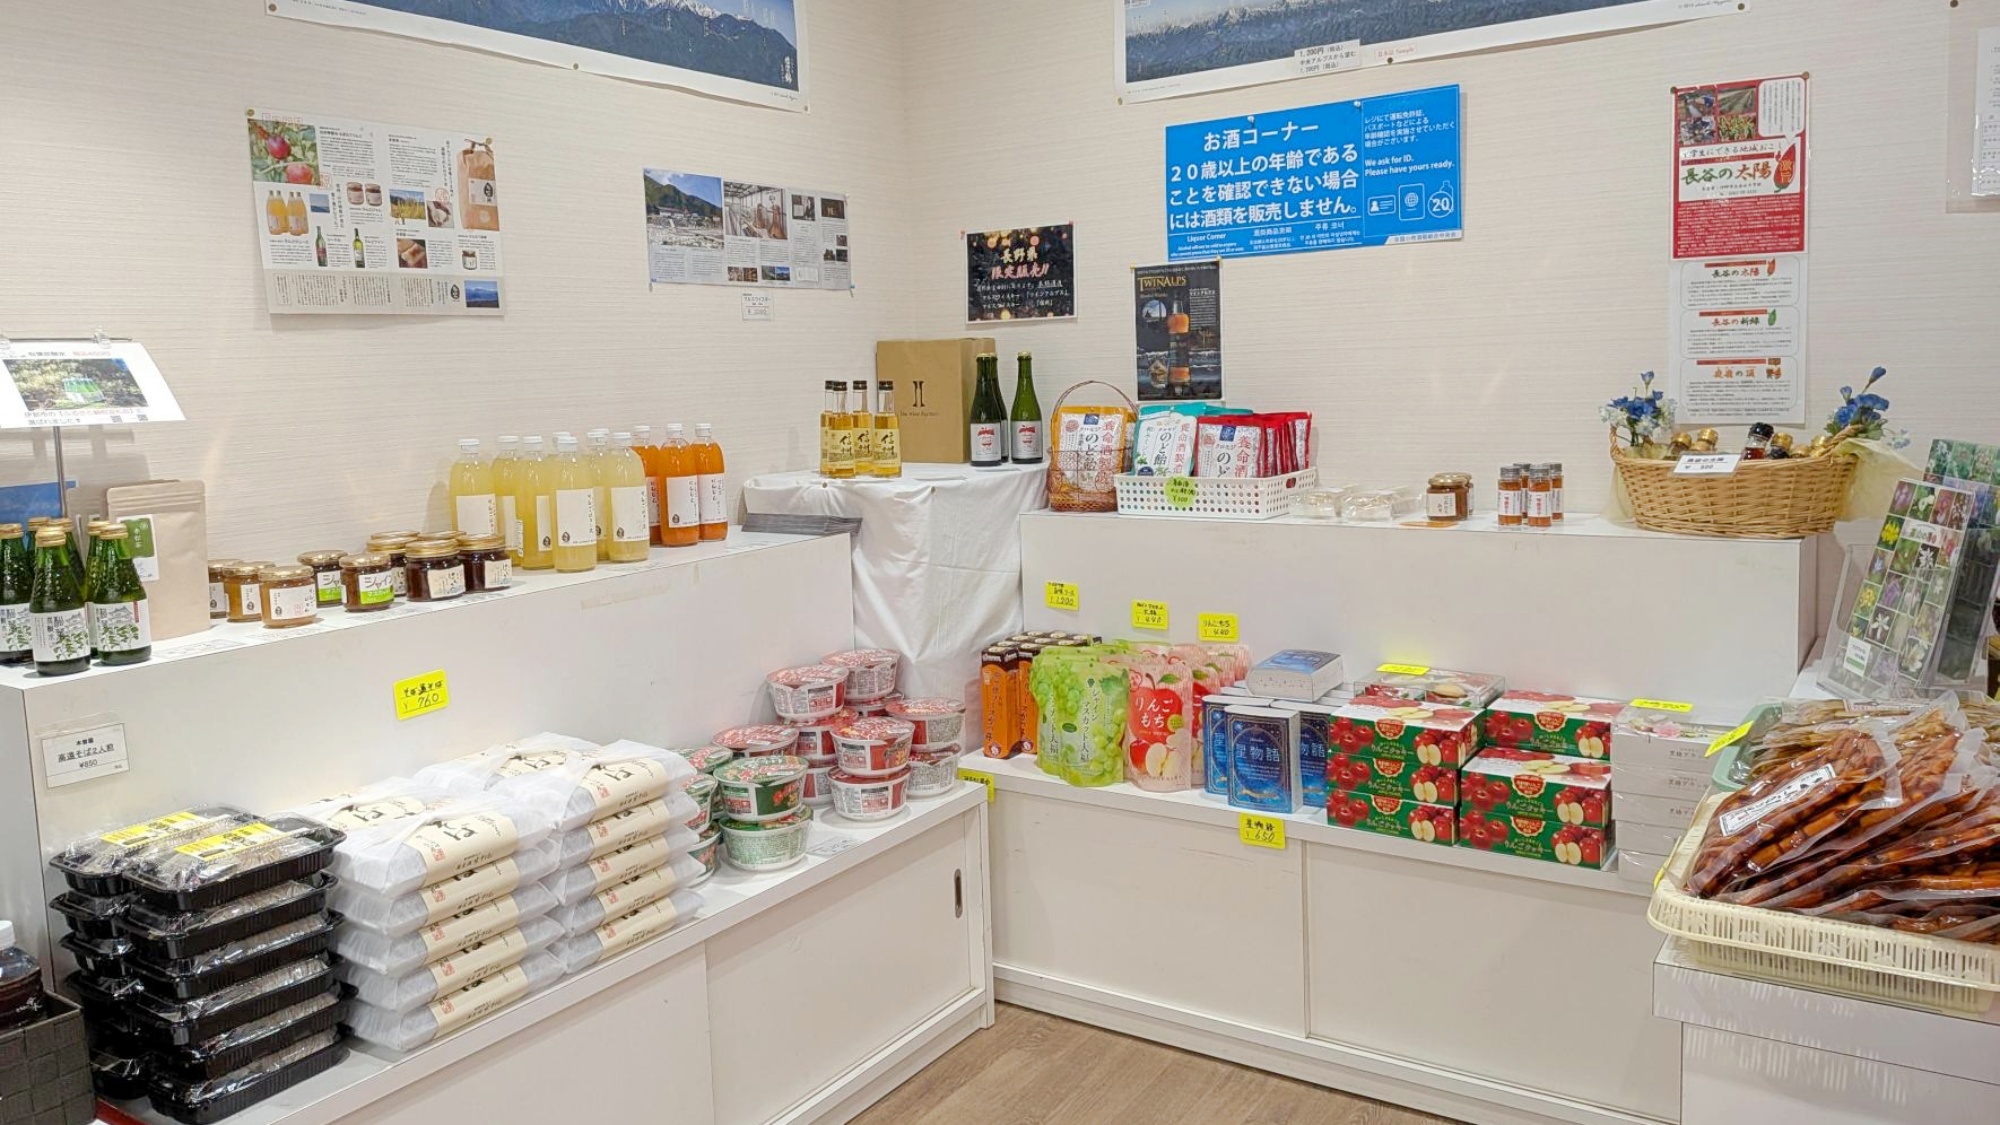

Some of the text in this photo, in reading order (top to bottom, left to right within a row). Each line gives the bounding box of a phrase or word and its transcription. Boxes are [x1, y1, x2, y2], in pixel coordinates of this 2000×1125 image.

[1365, 117, 1429, 132] パスポートなどによる
[1203, 122, 1320, 152] お酒コーナー
[1365, 159, 1376, 167] We
[1391, 155, 1402, 163] for
[1403, 154, 1414, 162] ID.
[1365, 160, 1455, 176] Please have yours ready.
[1681, 161, 1772, 185] 長谷の太陽
[1170, 168, 1359, 206] ことを確認できない場合
[1170, 195, 1358, 231] には酒類を販売しません。
[1432, 197, 1450, 212] 20
[1187, 232, 1226, 243] Liquor Corner
[1000, 246, 1038, 264] 長野県
[1137, 275, 1187, 292] TWINALPS
[1153, 432, 1172, 466] のど飴
[1135, 696, 1175, 713] りんご
[1140, 713, 1165, 729] もち
[1235, 743, 1281, 762] 星物語
[1254, 829, 1276, 842] 650
